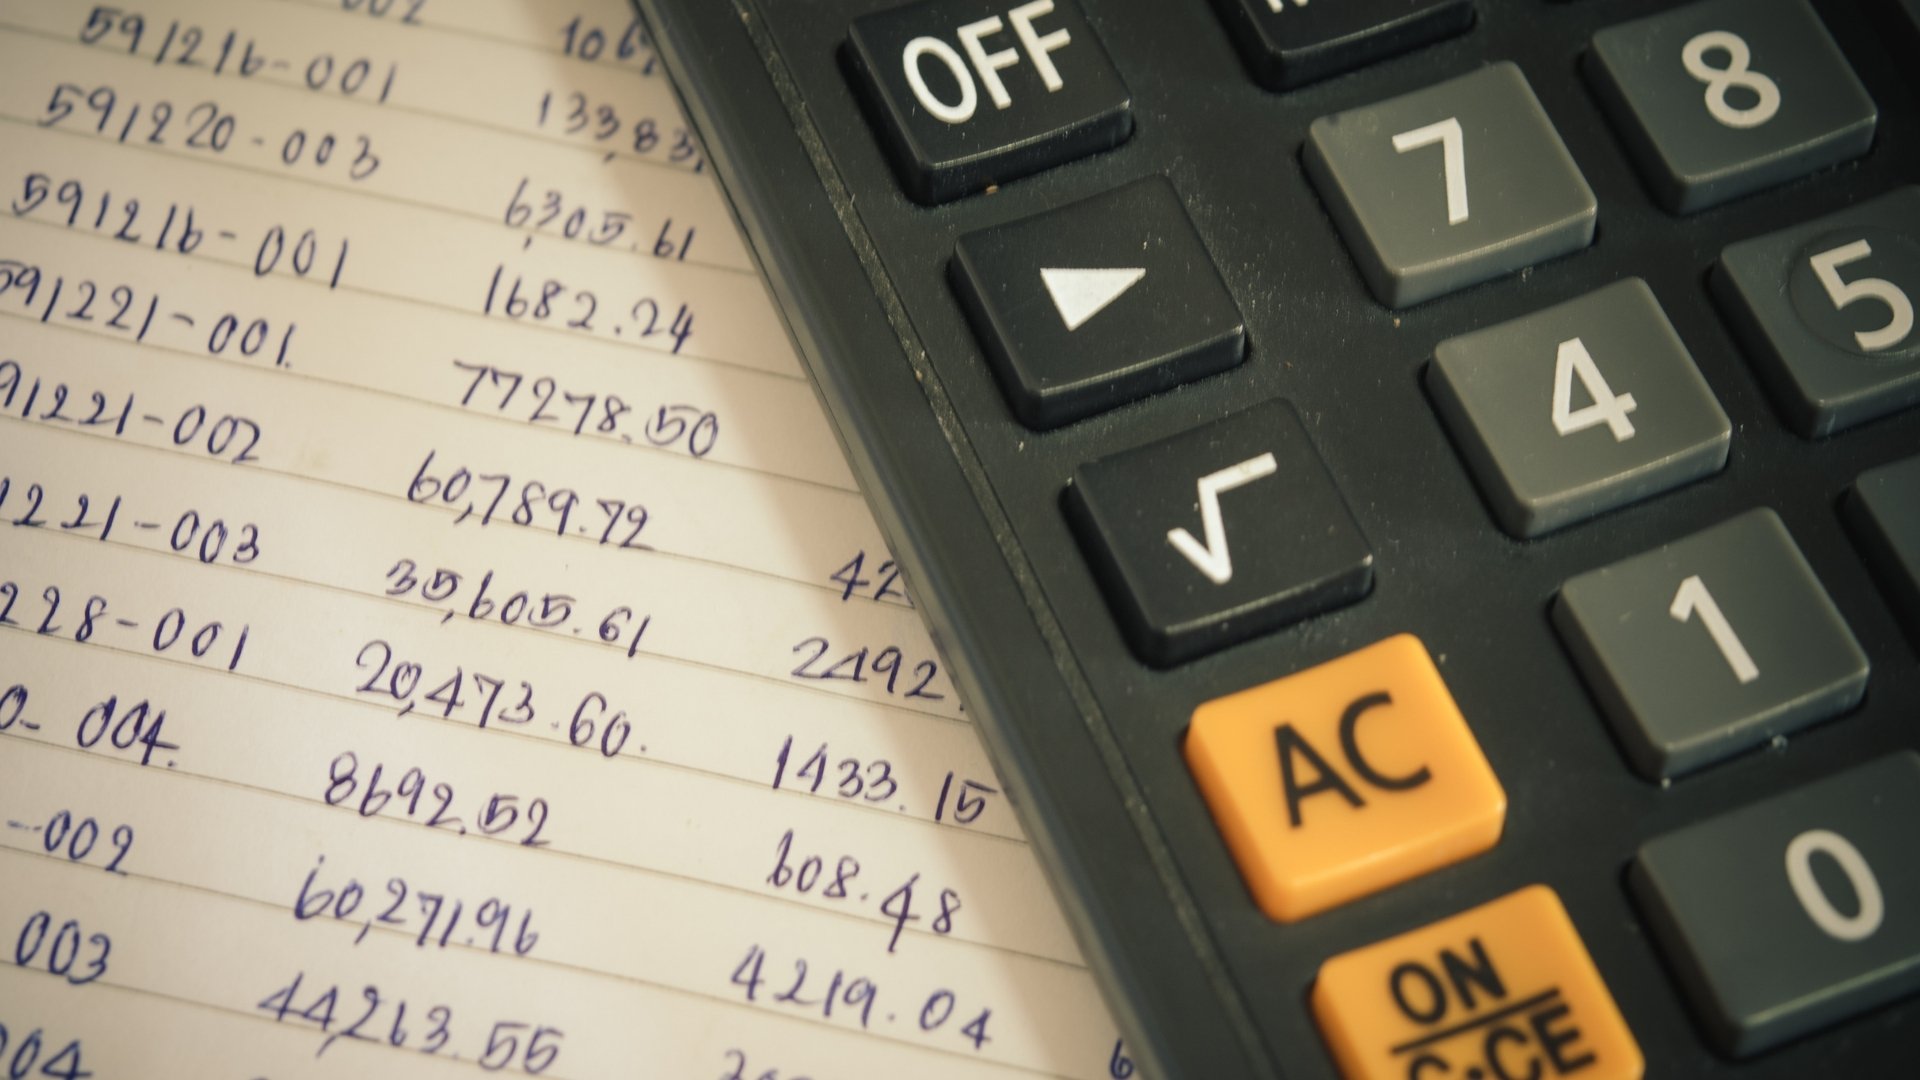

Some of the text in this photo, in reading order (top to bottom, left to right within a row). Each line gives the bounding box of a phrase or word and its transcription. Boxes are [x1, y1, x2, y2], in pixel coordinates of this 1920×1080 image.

[902, 0, 1071, 124] OFF
[1682, 31, 1781, 128] 8
[1392, 117, 1469, 226] 7
[484, 265, 695, 355] 1682.24
[1810, 239, 1915, 352] 5
[452, 358, 720, 459] 77278.50
[1552, 337, 1638, 442] 4
[405, 450, 656, 552] 60,789.72
[385, 558, 652, 658] 35,605.61
[1669, 575, 1760, 684] 1
[324, 750, 552, 848] 8692.52
[1273, 690, 1433, 829] AC
[765, 827, 962, 954] 608.48
[1784, 829, 1885, 942] 0
[14, 910, 112, 986] 003
[730, 943, 993, 1051] 4219.04
[1390, 937, 1507, 1025] ON
